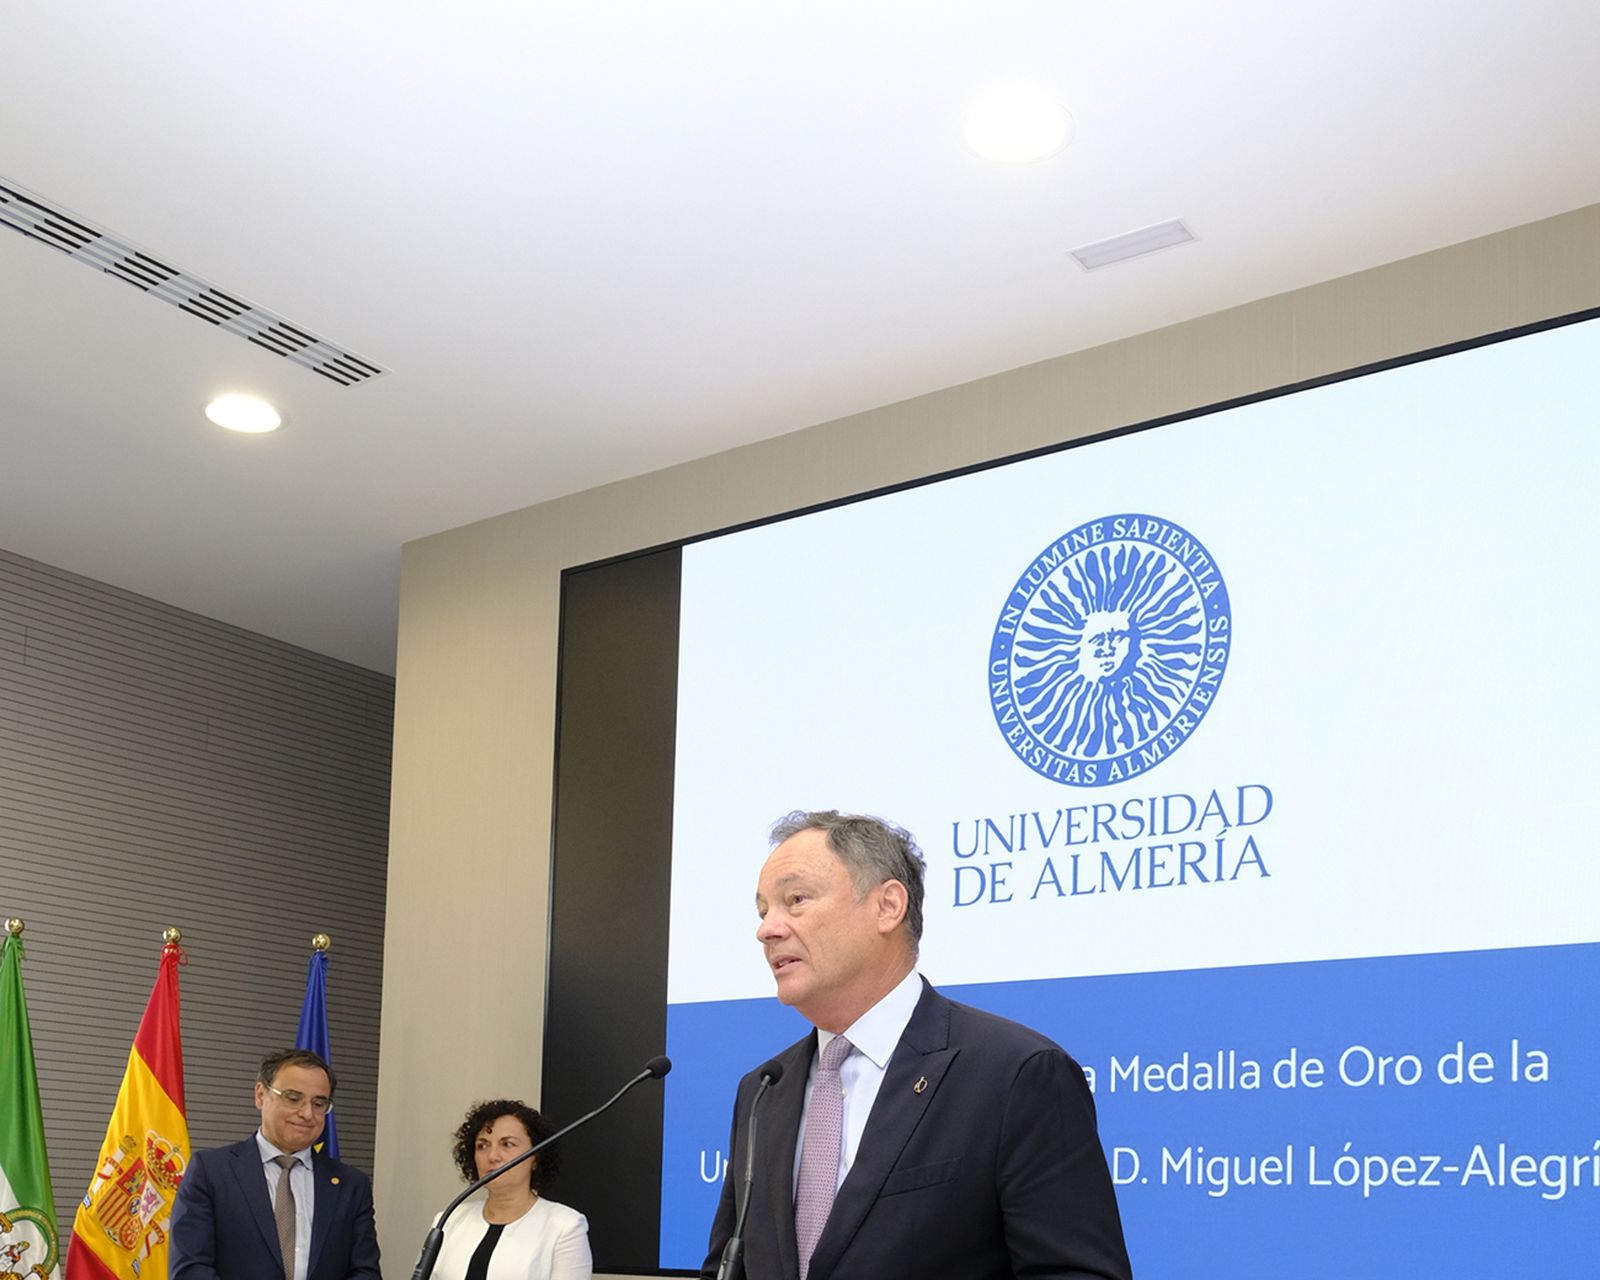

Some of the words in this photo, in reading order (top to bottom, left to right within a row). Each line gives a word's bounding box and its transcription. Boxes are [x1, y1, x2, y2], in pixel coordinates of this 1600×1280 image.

[999, 605, 1022, 636] IN
[1016, 523, 1105, 601] LUMINE
[1112, 518, 1221, 600] SAPIENTIA
[990, 660, 1098, 784] UNIVERSITAS
[1107, 615, 1229, 783] ALMERIENSIS
[952, 784, 1273, 859] UNIVERSIDAD
[952, 861, 1014, 908] DE
[1030, 828, 1271, 900] ALMERÍA
[1110, 1050, 1261, 1093] Medalla
[1273, 1047, 1325, 1089] de
[1338, 1045, 1423, 1087] Oro
[1437, 1041, 1495, 1084] de
[1511, 1038, 1549, 1082] la
[1112, 1147, 1148, 1185] D.
[1161, 1145, 1293, 1198] Miguel
